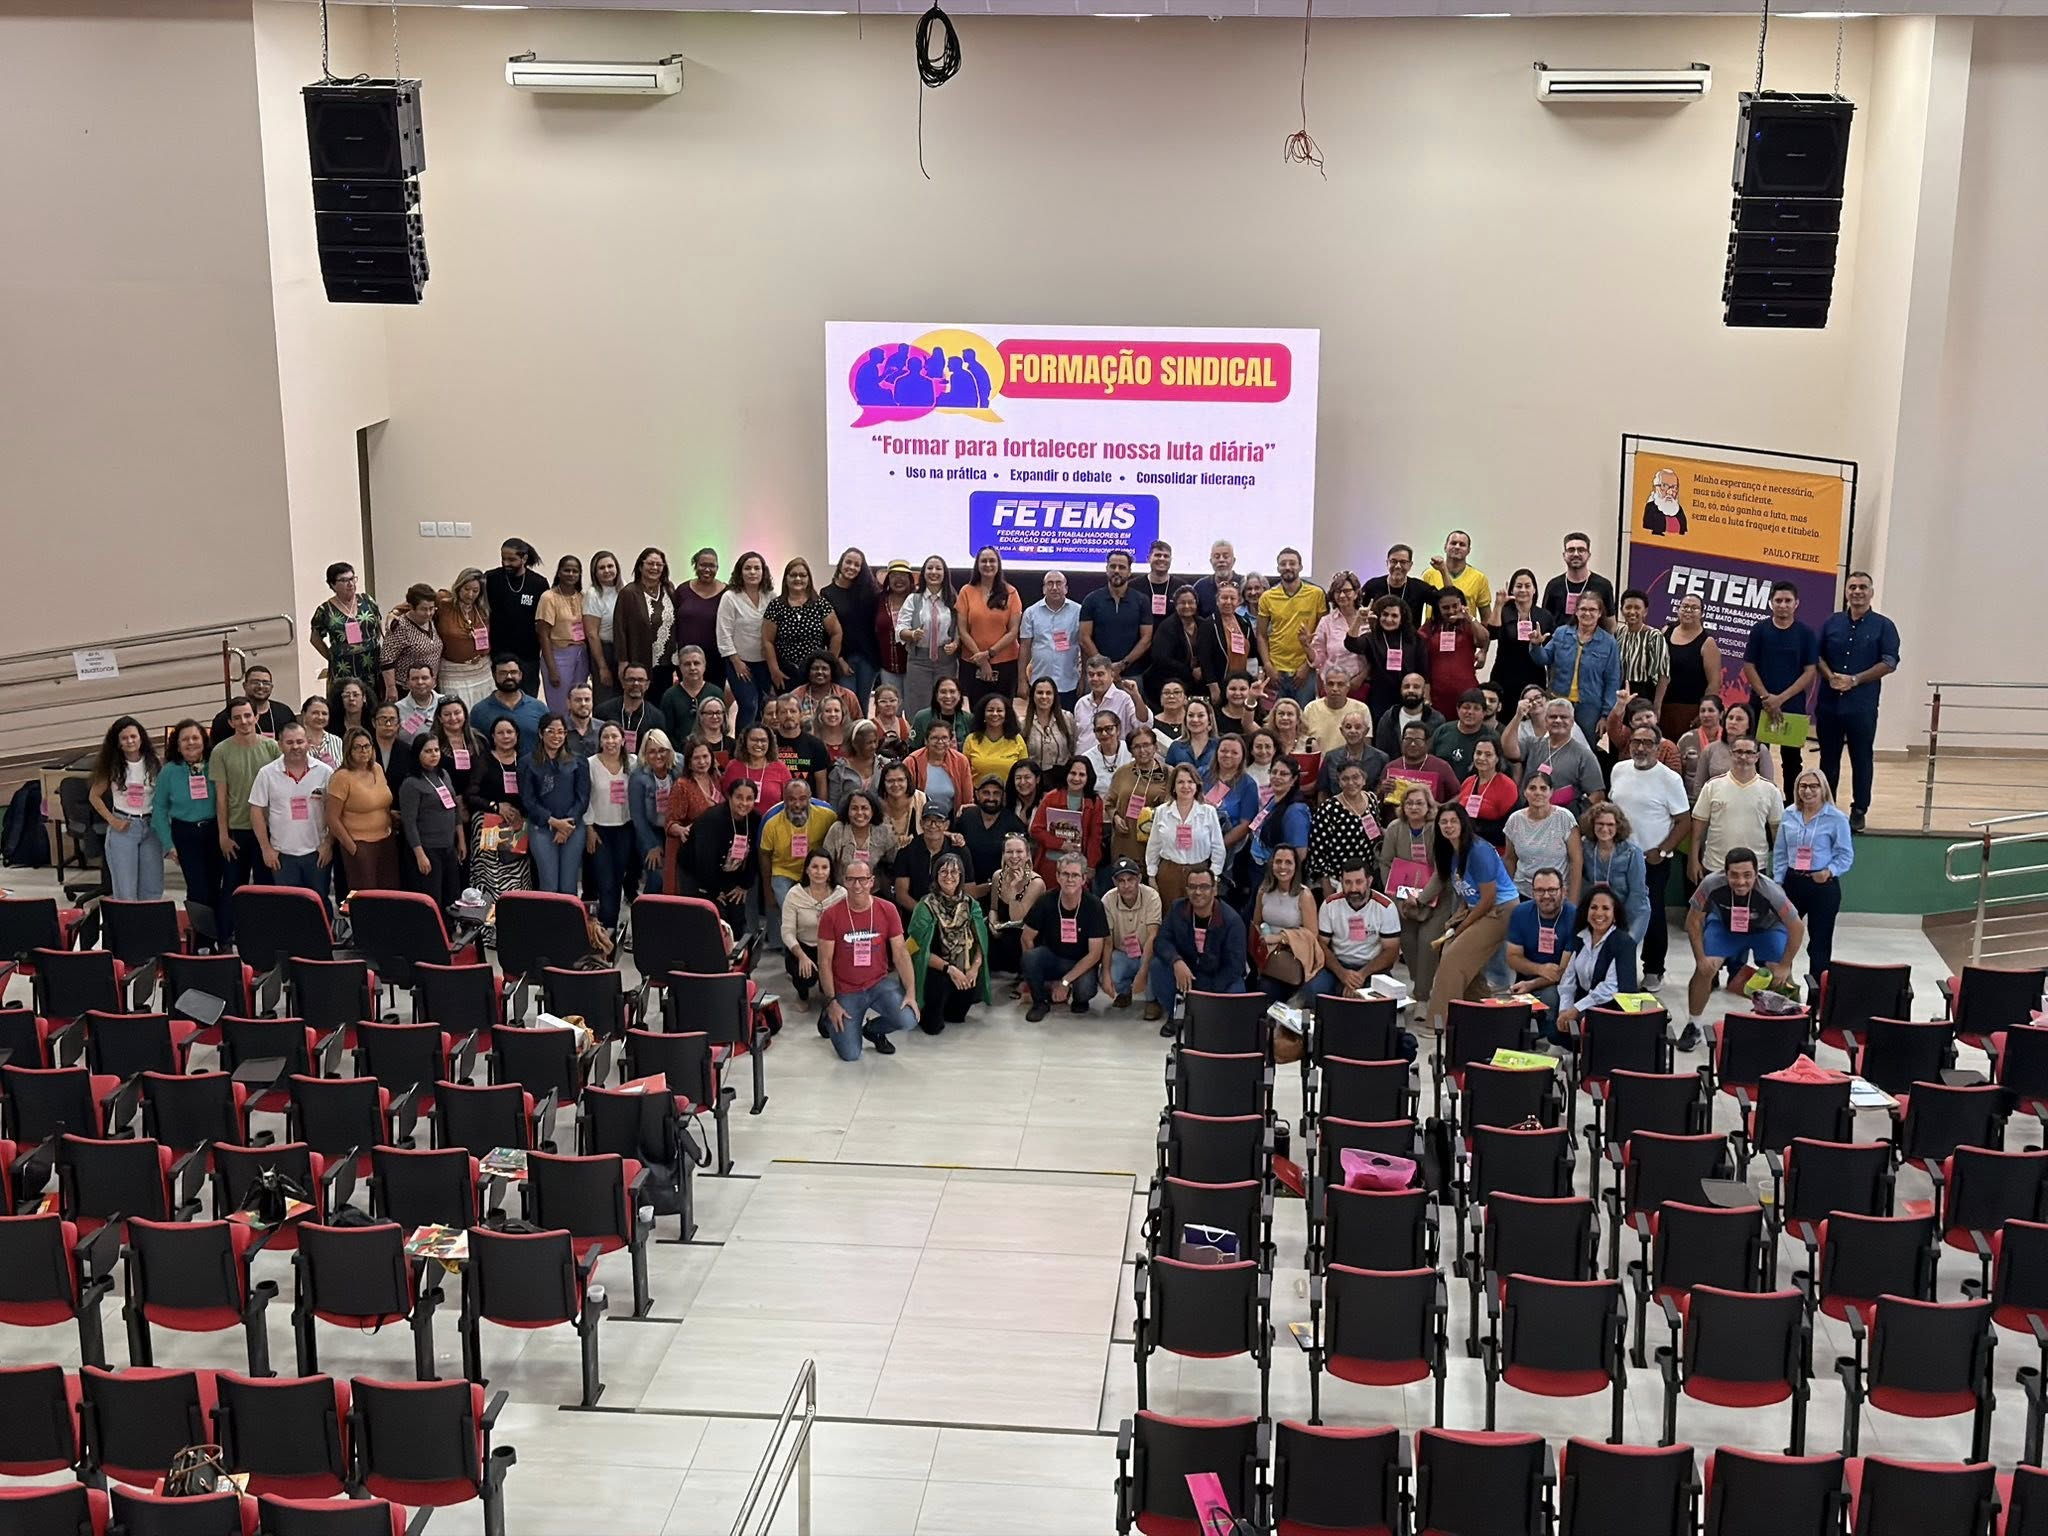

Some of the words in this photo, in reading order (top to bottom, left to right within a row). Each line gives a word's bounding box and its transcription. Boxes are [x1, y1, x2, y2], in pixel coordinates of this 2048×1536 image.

[1009, 348, 1151, 394] FORMAÇÃO
[1160, 356, 1277, 387] SINDICAL
[955, 439, 997, 459] para
[1003, 438, 1098, 459] fortalecer
[1103, 442, 1161, 460] nossa
[1167, 441, 1203, 461] luta
[906, 466, 926, 479] Uso
[930, 468, 943, 479] na
[946, 466, 987, 481] prática
[1010, 468, 1059, 483] Expandir
[1062, 473, 1069, 482] o
[1072, 469, 1112, 483] debate
[1136, 471, 1198, 484] Consolidar
[1201, 472, 1255, 489] liderança
[1694, 474, 1719, 485] Minha
[1720, 479, 1761, 492] esperança
[1693, 488, 1709, 496] mas
[1711, 490, 1726, 498] não
[1727, 491, 1732, 499] é
[992, 499, 1136, 529] FETEMS
[1720, 503, 1735, 512] não
[1736, 506, 1762, 516] ganha
[1790, 514, 1808, 523] mas
[1692, 513, 1707, 521] sem
[1708, 514, 1720, 523] ela
[1728, 516, 1744, 526] luta
[1745, 519, 1780, 533] fraqueja
[997, 529, 1040, 538] FEDERAÇÃO
[1058, 531, 1119, 539] TRABALHADORES
[999, 536, 1039, 545] EDUCAÇÃO
[1072, 538, 1102, 546] GROSSO
[1763, 547, 1790, 558] PAULO
[1792, 551, 1820, 563] FREIRE
[1667, 565, 1774, 610] FETEM
[1708, 604, 1720, 612] DOS
[1715, 614, 1731, 623] MATO
